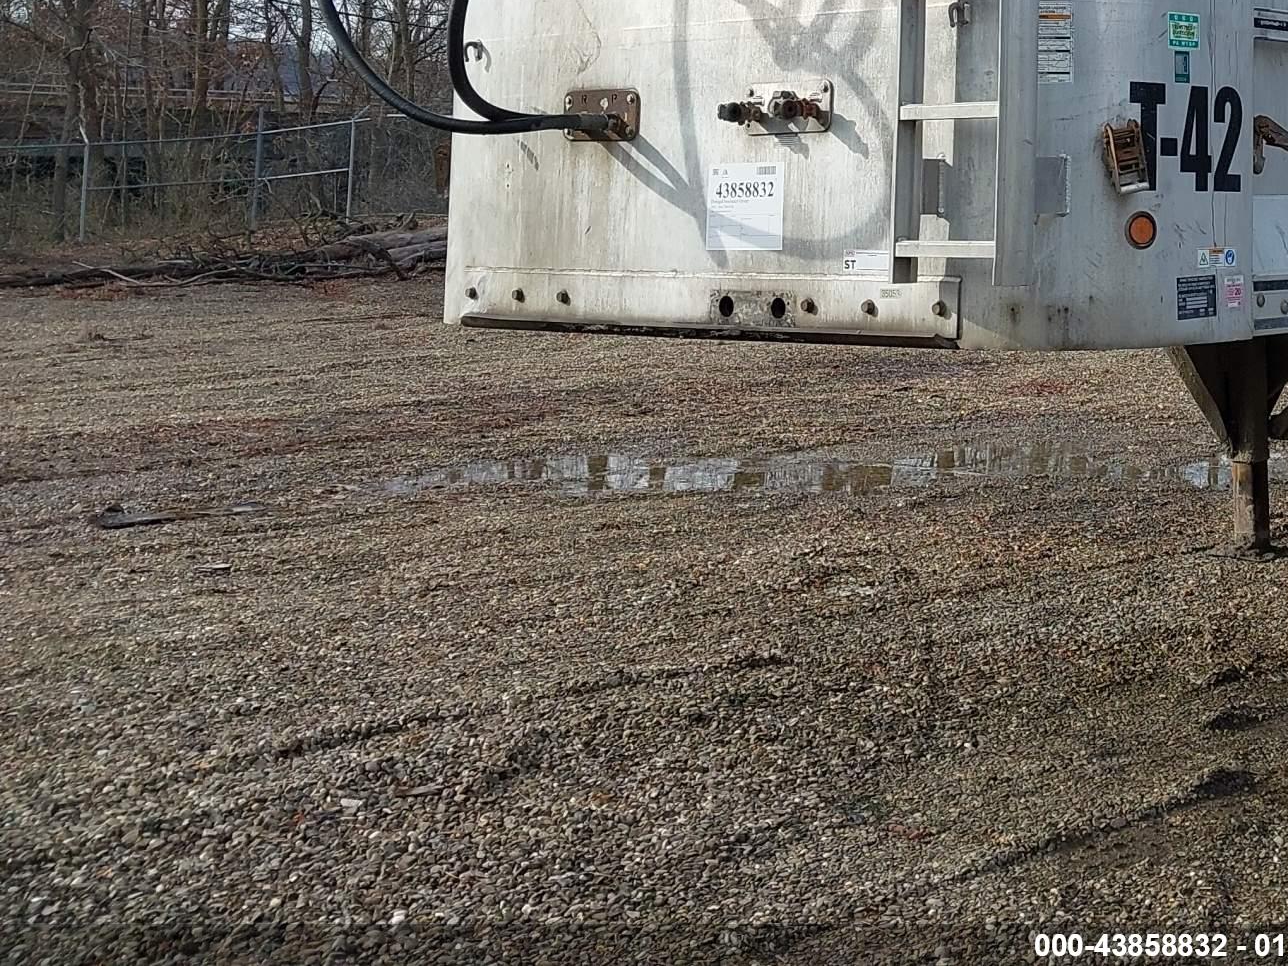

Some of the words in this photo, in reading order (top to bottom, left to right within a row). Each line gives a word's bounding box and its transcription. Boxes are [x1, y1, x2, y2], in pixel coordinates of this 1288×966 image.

[581, 94, 588, 105] R
[611, 94, 618, 105] P
[1129, 81, 1243, 193] T-42
[715, 181, 774, 199] 43858832
[844, 259, 857, 270] ST
